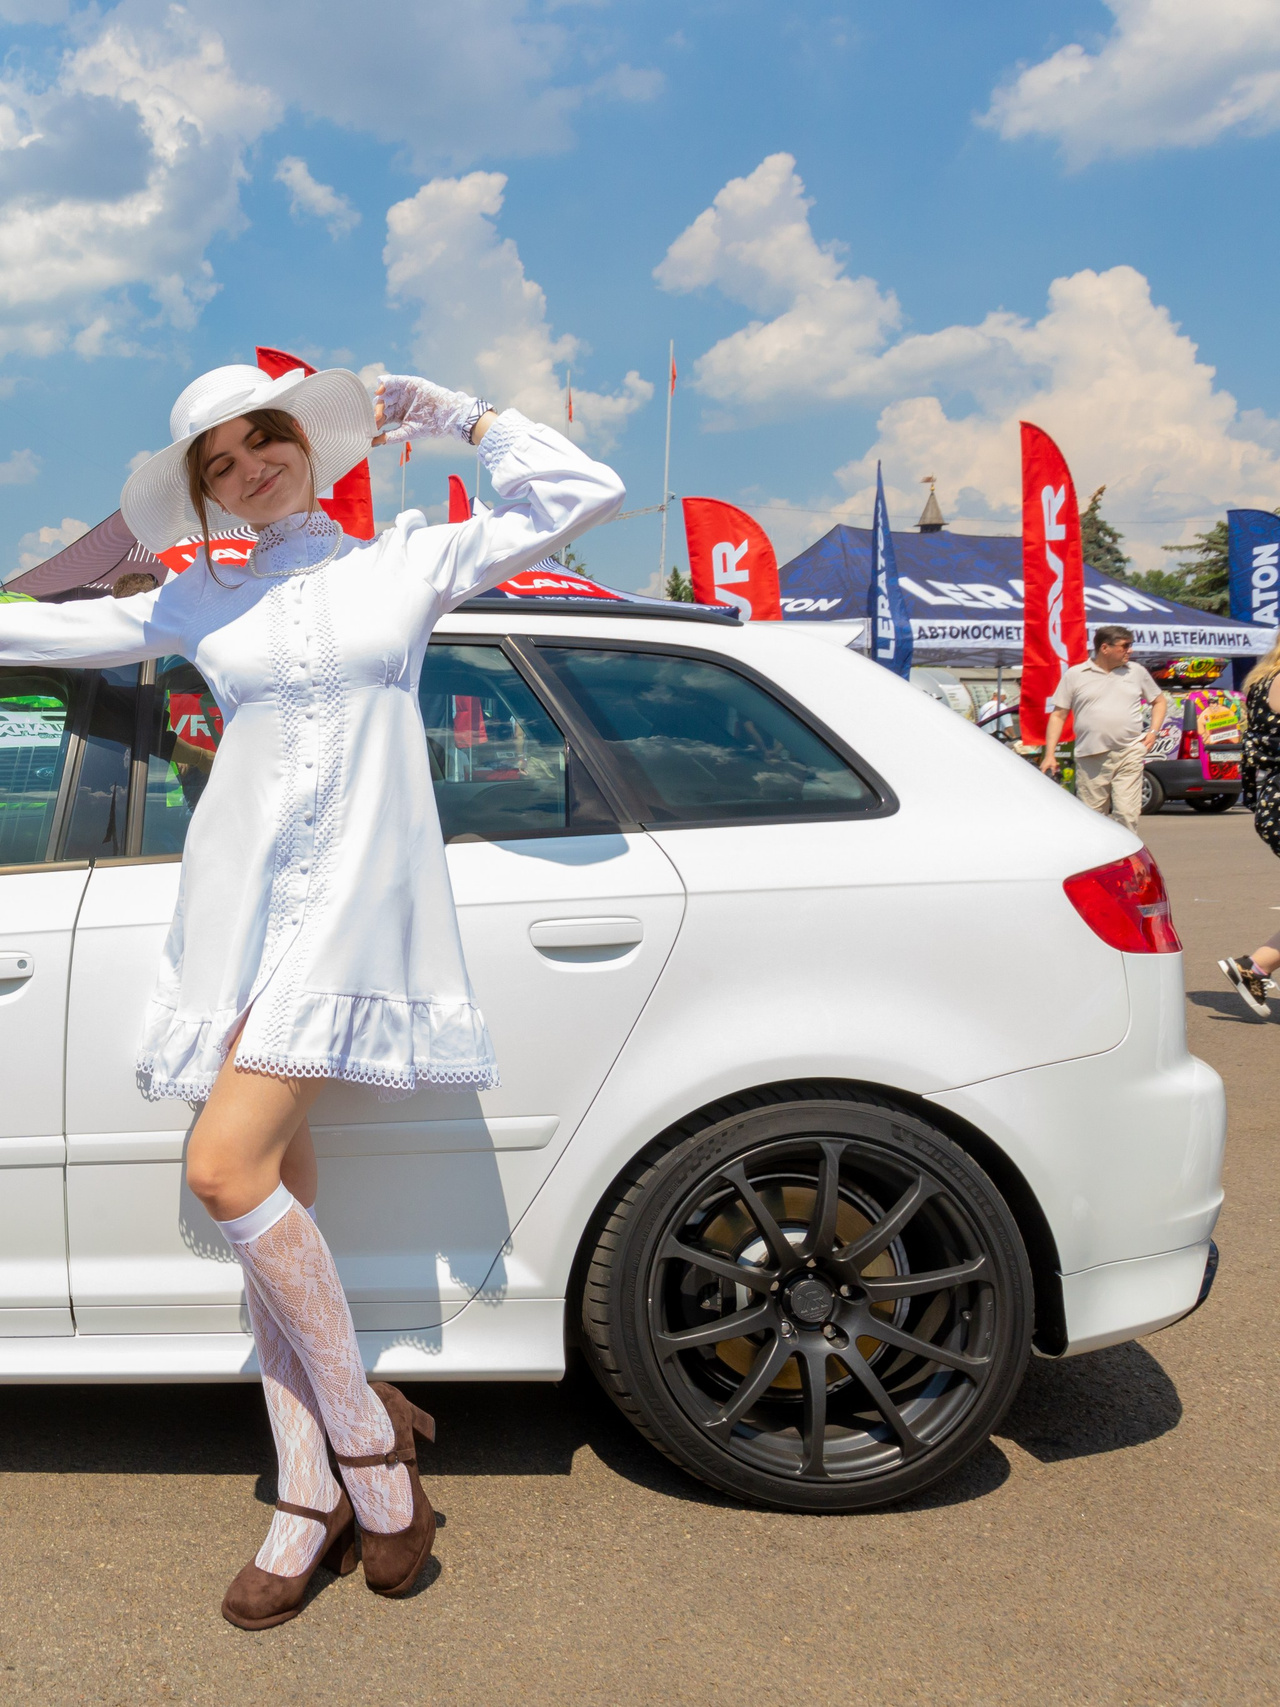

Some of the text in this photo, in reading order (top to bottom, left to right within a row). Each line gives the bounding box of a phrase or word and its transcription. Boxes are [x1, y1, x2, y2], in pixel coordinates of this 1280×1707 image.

[507, 578, 595, 593] LAVR
[711, 539, 753, 621] VR
[1251, 543, 1280, 628] ATON
[917, 625, 1024, 641] АВТОКОСМЕТ
[1163, 629, 1252, 647] ДЕТЕЙЛИНГА
[169, 714, 211, 737] VR
[916, 1138, 998, 1219] MICHELIN
